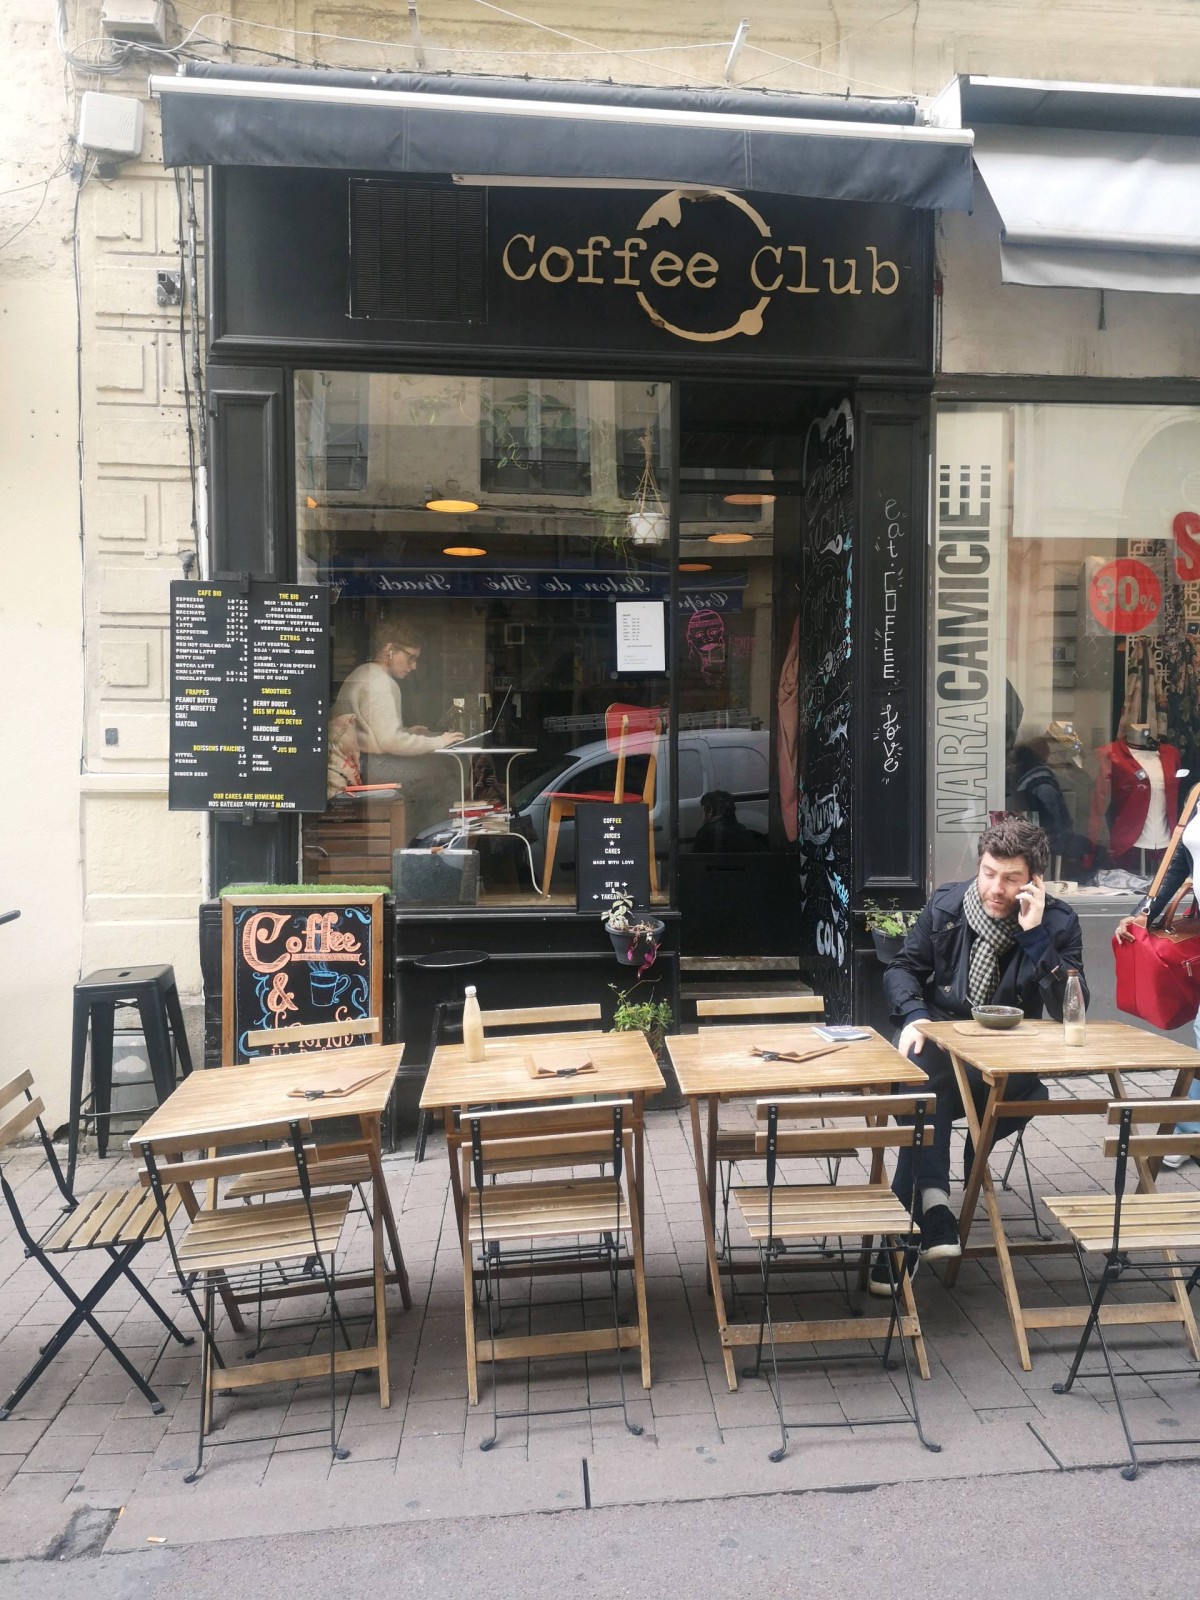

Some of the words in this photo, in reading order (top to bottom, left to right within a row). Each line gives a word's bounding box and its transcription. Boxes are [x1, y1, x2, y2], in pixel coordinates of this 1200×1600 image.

[502, 233, 719, 290] Coffee
[750, 245, 900, 295] Club
[197, 589, 212, 597] CAFE
[280, 634, 301, 642] EXTRAS
[185, 688, 210, 696] FRAPPES
[261, 687, 292, 695] SMOOTHIES
[175, 696, 196, 704] PEANUT
[220, 745, 246, 753] FRAICHES
[243, 793, 254, 801] ARE
[220, 800, 244, 808] GATEAUX
[275, 801, 296, 809] MAISON
[603, 817, 623, 825] COFFEE
[242, 911, 361, 974] Coffee
[267, 972, 299, 1012] &
